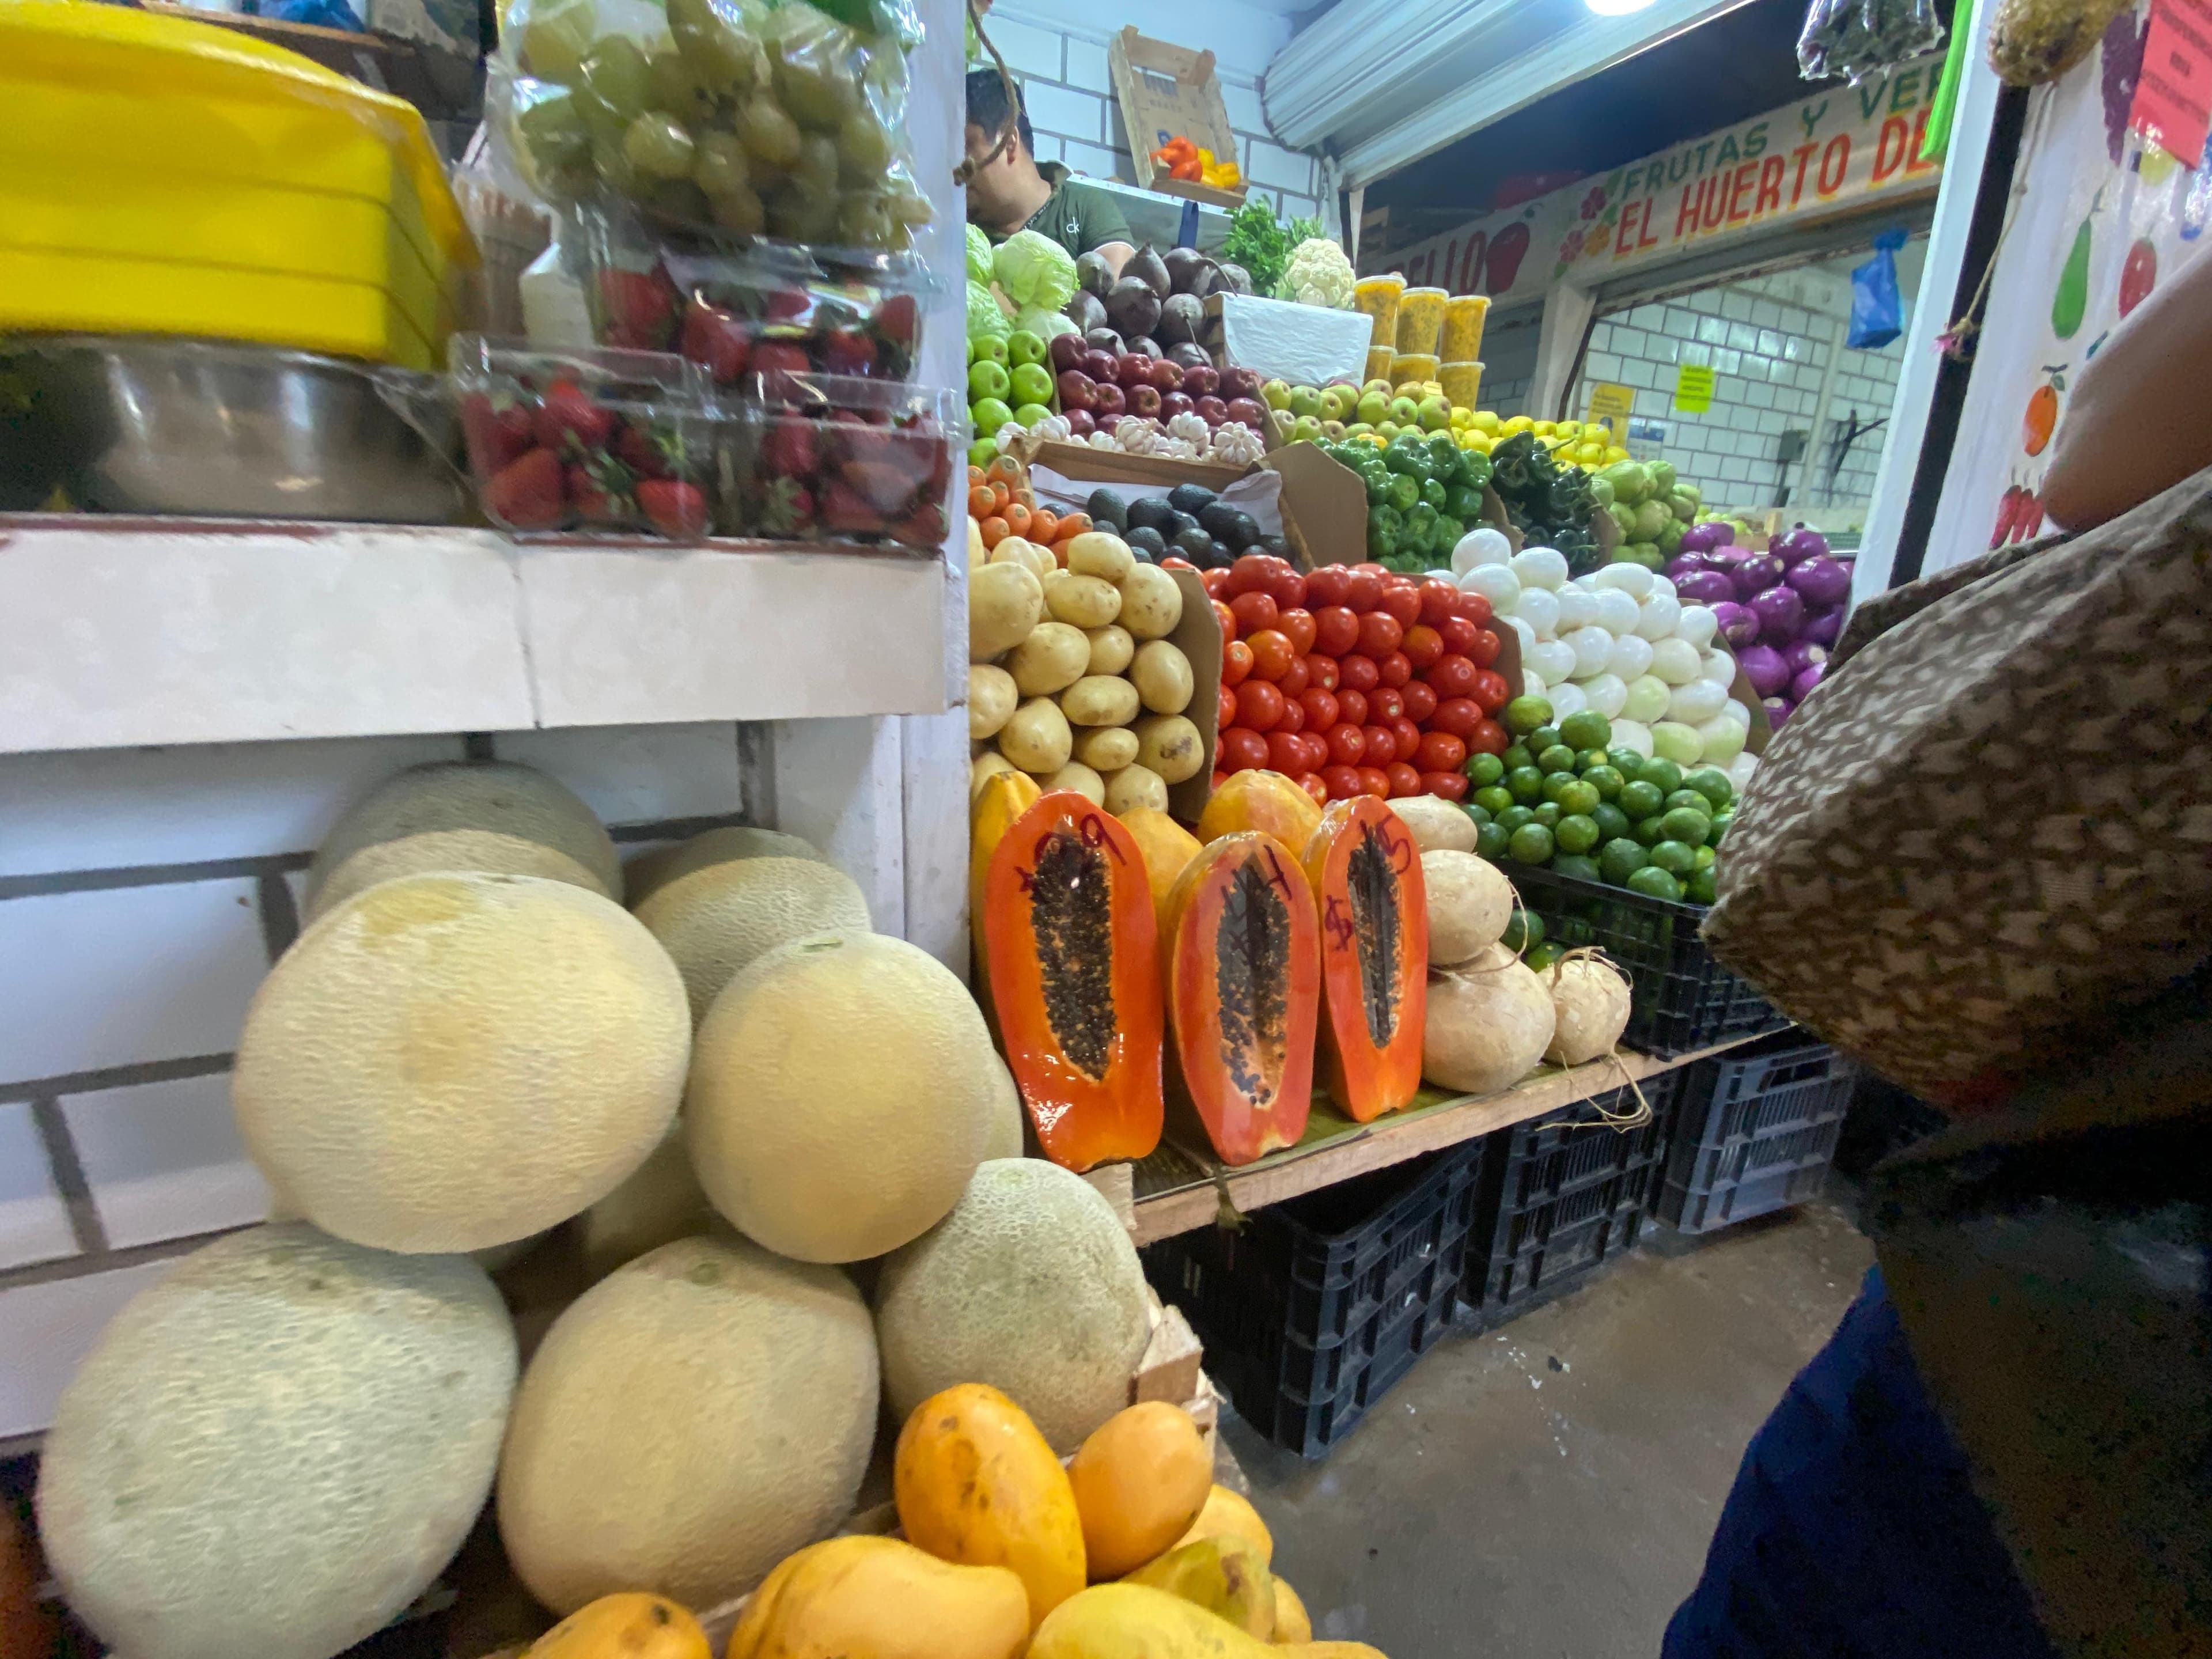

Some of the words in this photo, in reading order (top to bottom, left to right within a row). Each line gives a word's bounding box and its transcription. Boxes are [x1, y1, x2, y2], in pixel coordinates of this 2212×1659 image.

[1615, 197, 1658, 254] EL
[1675, 133, 1851, 237] HUERTO
[1622, 121, 1770, 200] FRUTAS
[1801, 99, 1829, 137] Y
